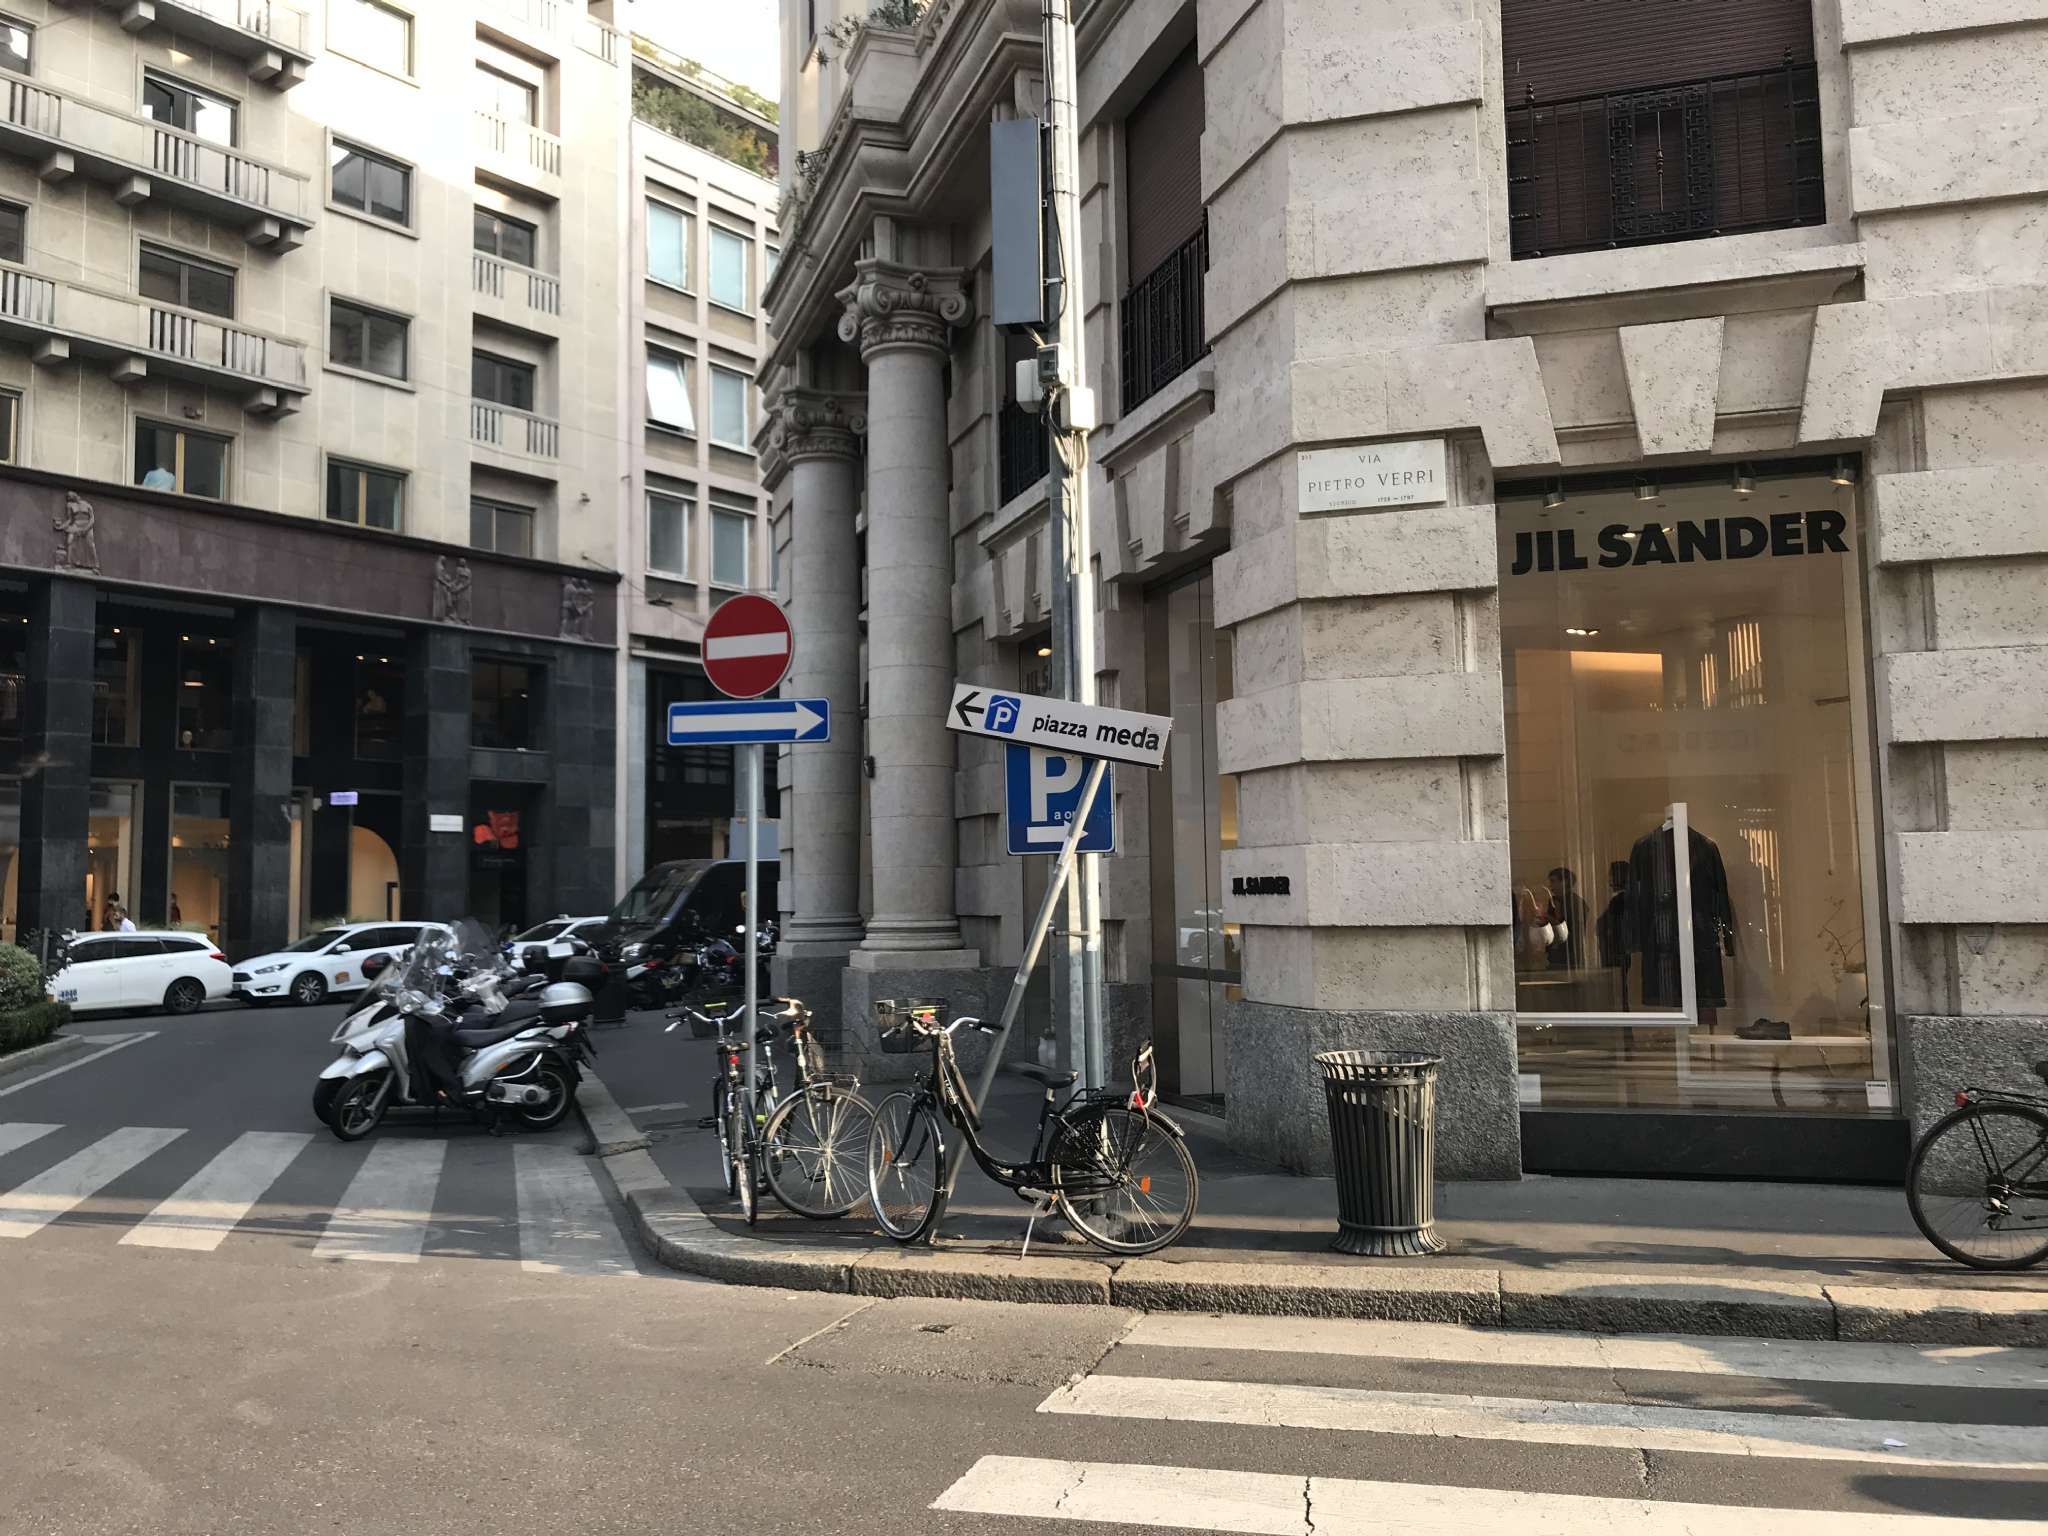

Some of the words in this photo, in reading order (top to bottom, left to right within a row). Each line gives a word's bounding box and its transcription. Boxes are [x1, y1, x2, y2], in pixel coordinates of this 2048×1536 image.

[1358, 454, 1382, 465] VIA
[1308, 477, 1366, 493] PIETRO
[1377, 469, 1434, 487] VERRI
[1511, 529, 1589, 576] JIL
[1596, 509, 1851, 568] SANDER
[1032, 715, 1088, 738] piazza
[1096, 724, 1160, 751] meda
[1029, 747, 1083, 822] P
